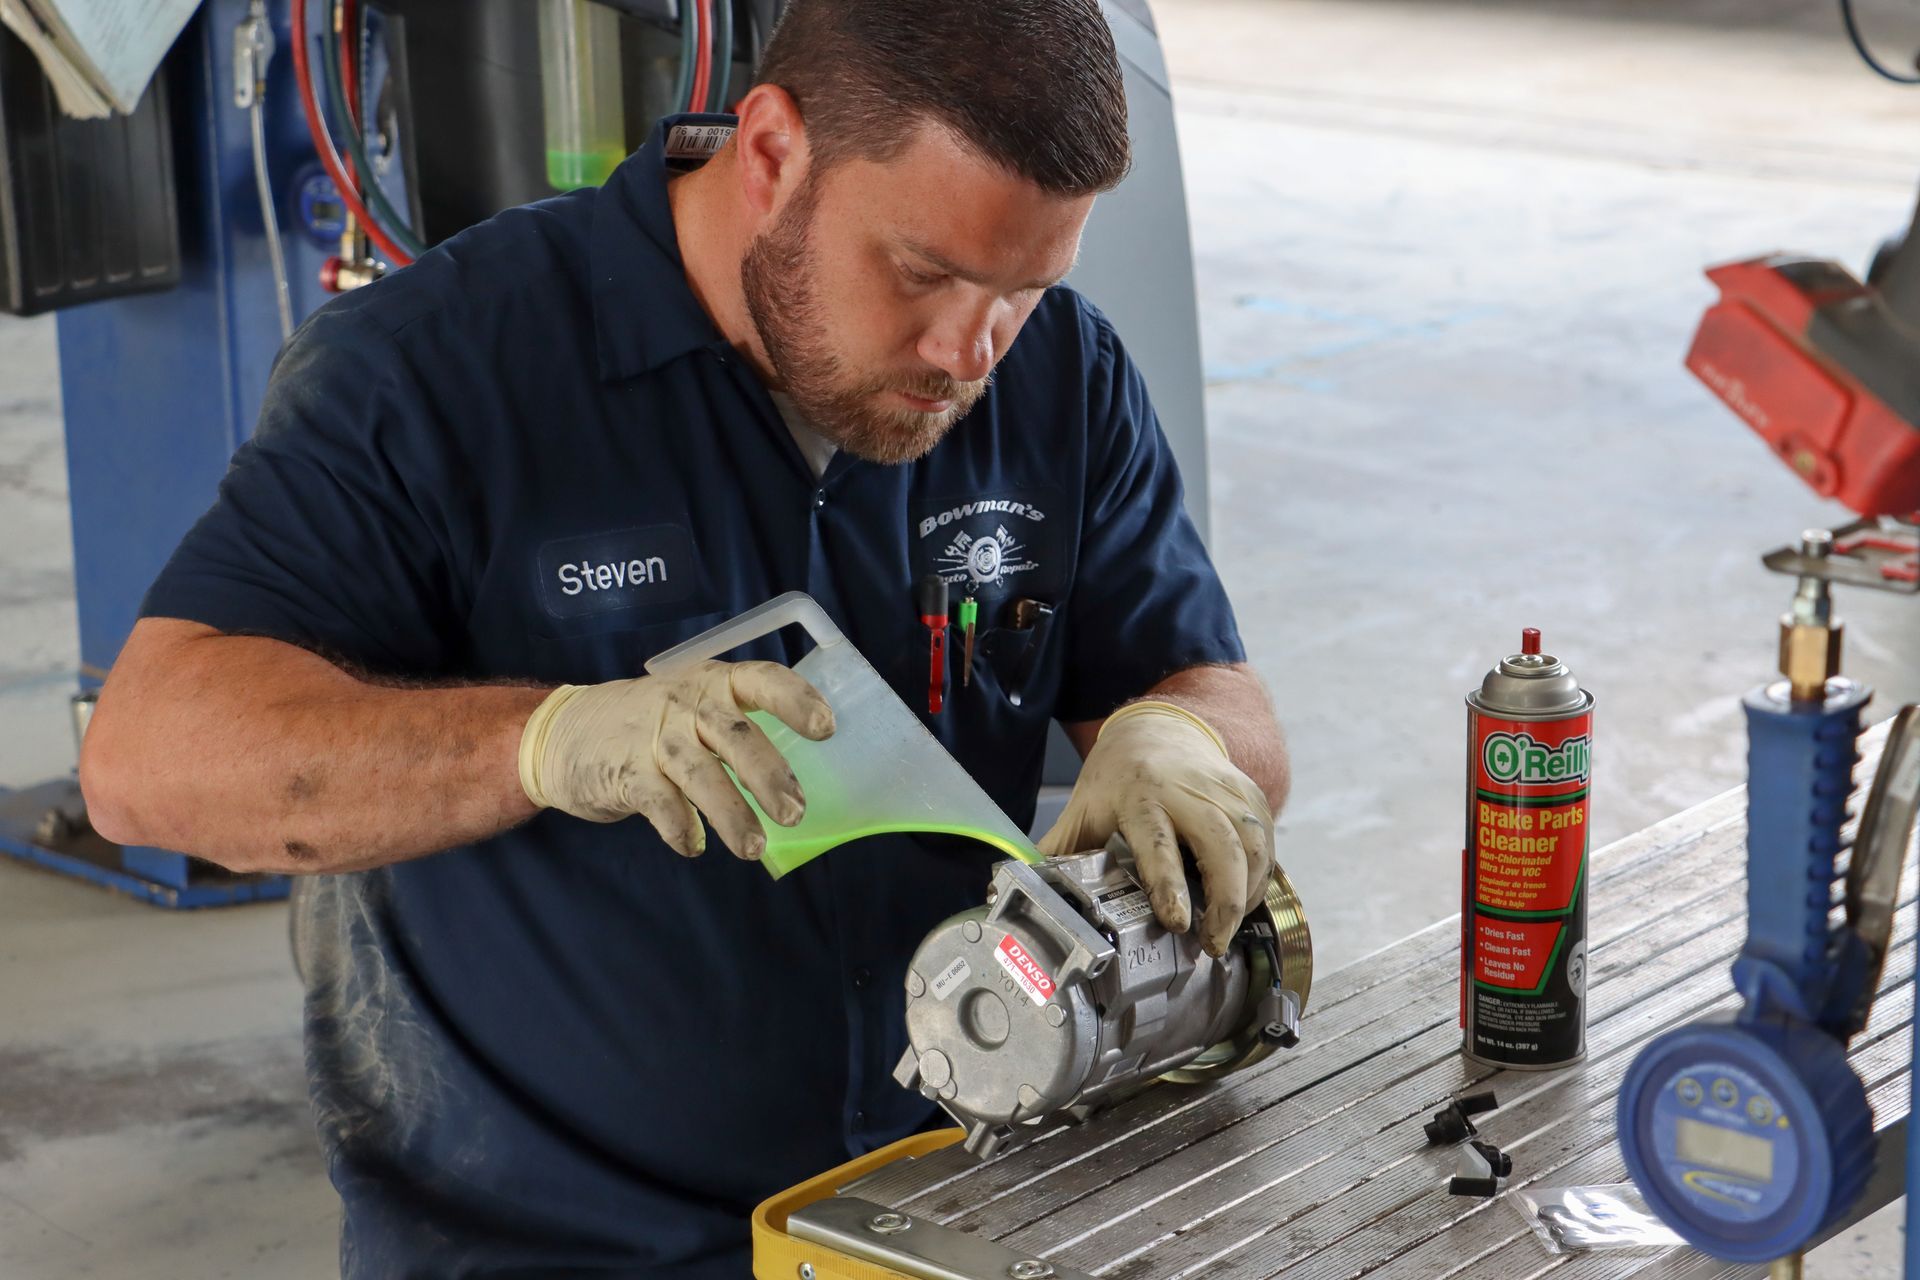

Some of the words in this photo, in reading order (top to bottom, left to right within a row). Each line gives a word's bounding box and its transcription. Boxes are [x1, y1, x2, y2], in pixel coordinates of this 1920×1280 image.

[676, 127, 688, 135] 76
[695, 128, 702, 136] 2
[919, 499, 1045, 539] Bowman's
[558, 556, 667, 595] Steven
[1480, 803, 1533, 831] Brake
[1539, 806, 1584, 831] Parts
[1479, 826, 1559, 853] Cleaner
[1480, 848, 1552, 866] Non-Chlorinated
[1480, 859, 1498, 873] Ultra
[1500, 865, 1520, 876] Low
[1522, 866, 1542, 877] VOC
[1511, 881, 1522, 889] de
[1522, 881, 1547, 889] frenos
[1505, 890, 1517, 898] sin
[1508, 900, 1525, 909] bajo
[1484, 926, 1505, 939] Dries
[1506, 930, 1525, 941] Fast
[1484, 941, 1511, 955] Cleans
[1512, 946, 1531, 956] Fast
[1008, 944, 1051, 990] DENSO
[1484, 957, 1511, 970] Leaves
[1513, 962, 1525, 972] No
[1484, 967, 1516, 981] Residue
